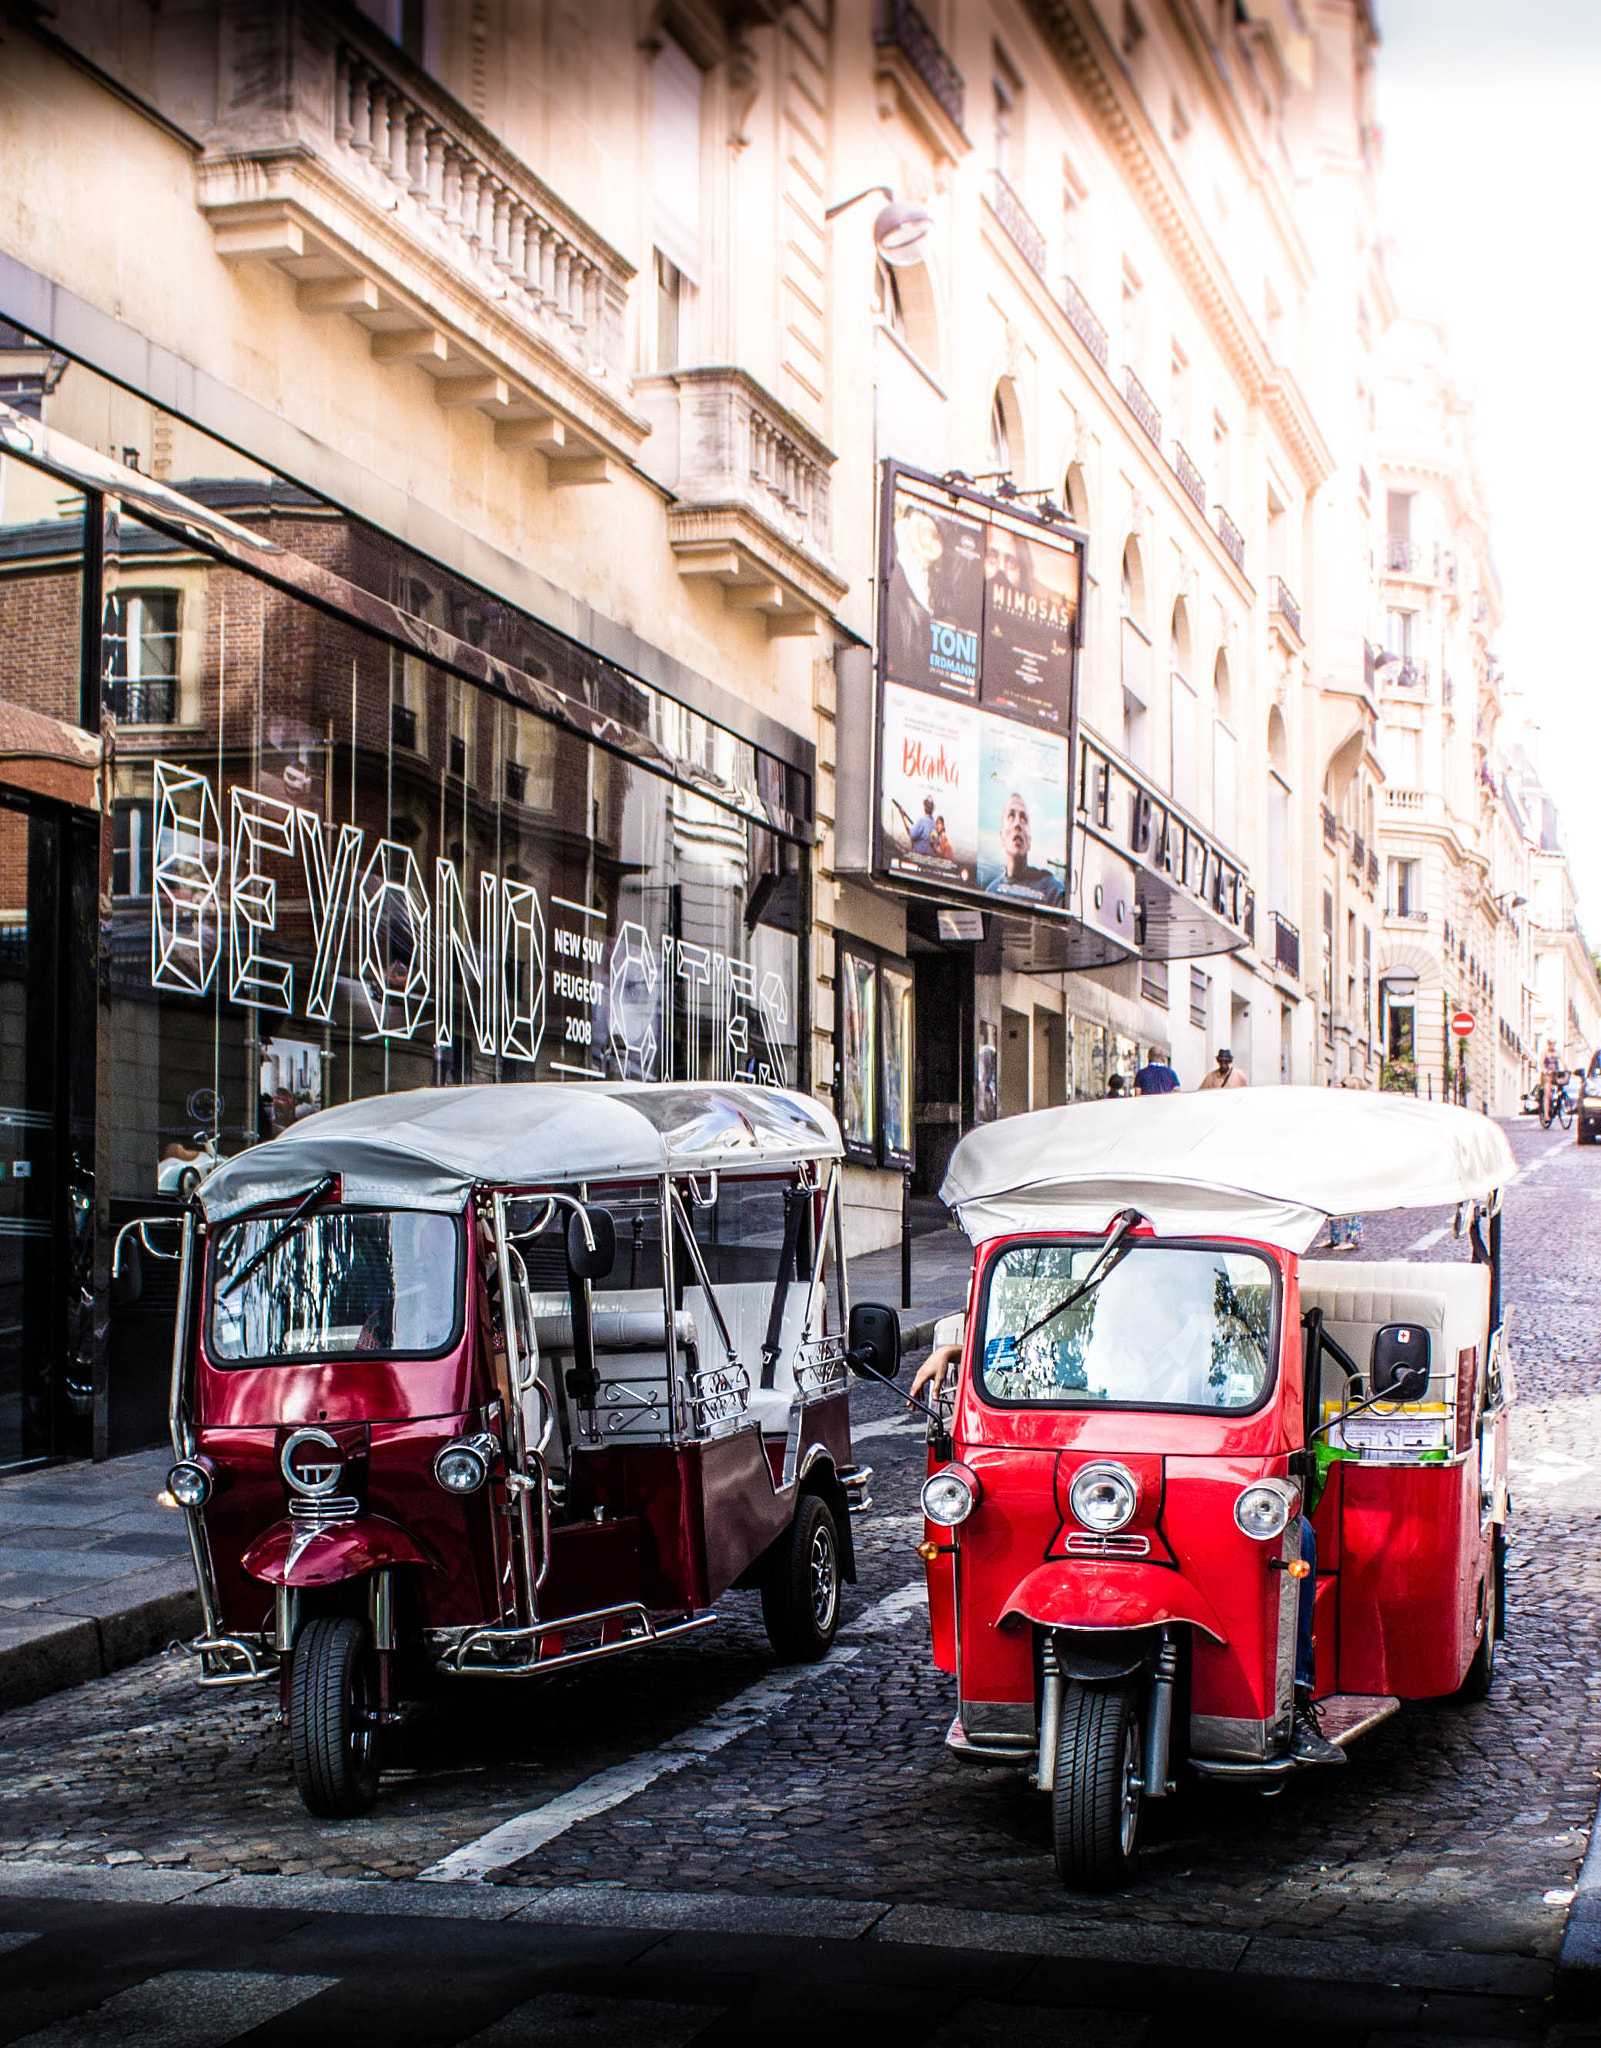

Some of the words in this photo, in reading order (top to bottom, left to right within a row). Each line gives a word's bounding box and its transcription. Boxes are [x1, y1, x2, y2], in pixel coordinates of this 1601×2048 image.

[993, 584, 1069, 627] MIMOSAS
[929, 623, 977, 665] TONI
[929, 653, 976, 679] ERDMANN
[903, 737, 959, 788] Blanka
[152, 759, 546, 1062] BEYOND
[554, 928, 581, 959] NEW
[582, 936, 604, 964] SUV
[553, 970, 604, 1006] PEUGEOT
[565, 1016, 592, 1045] 2008
